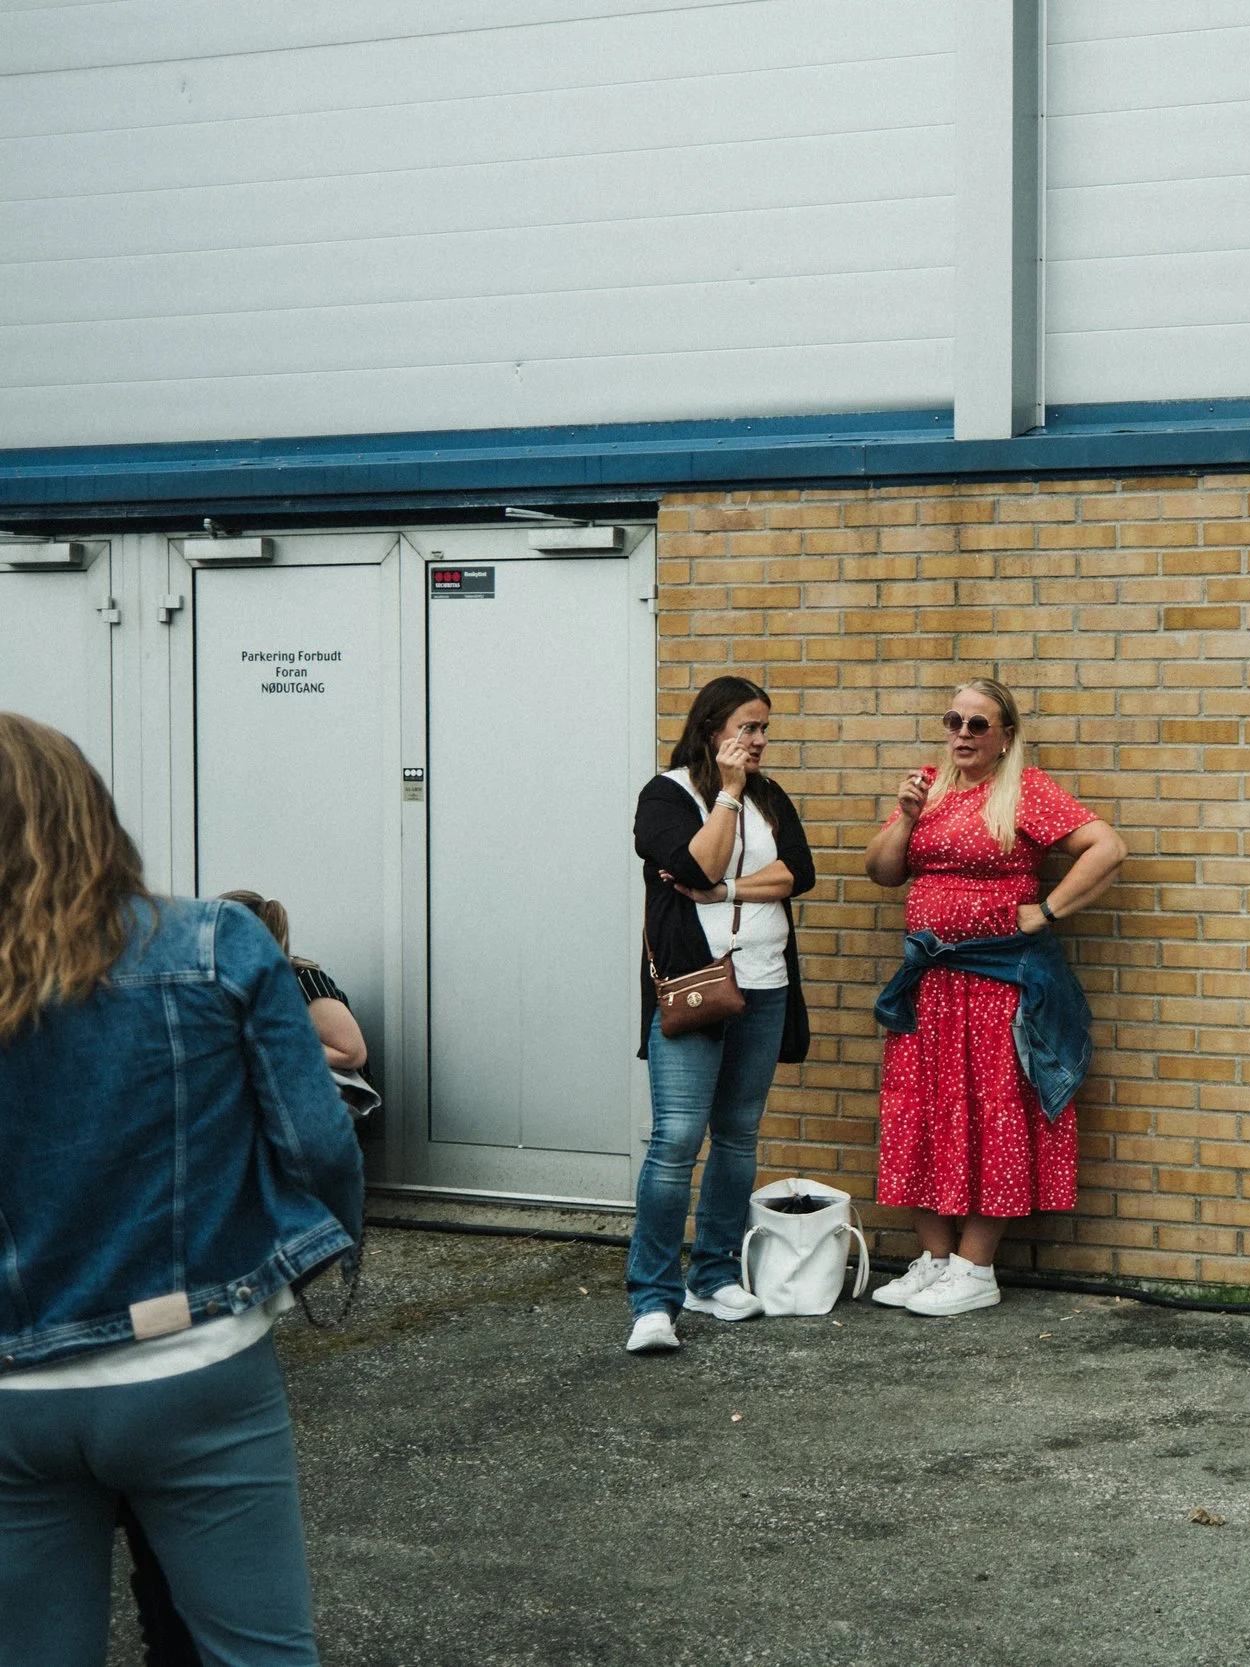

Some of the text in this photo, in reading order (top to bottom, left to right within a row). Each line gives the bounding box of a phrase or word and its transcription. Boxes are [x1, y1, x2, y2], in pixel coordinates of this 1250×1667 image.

[241, 650, 342, 664] Parkering Forbudt
[275, 666, 308, 678] Foran
[261, 682, 325, 694] NØDUTGANG
